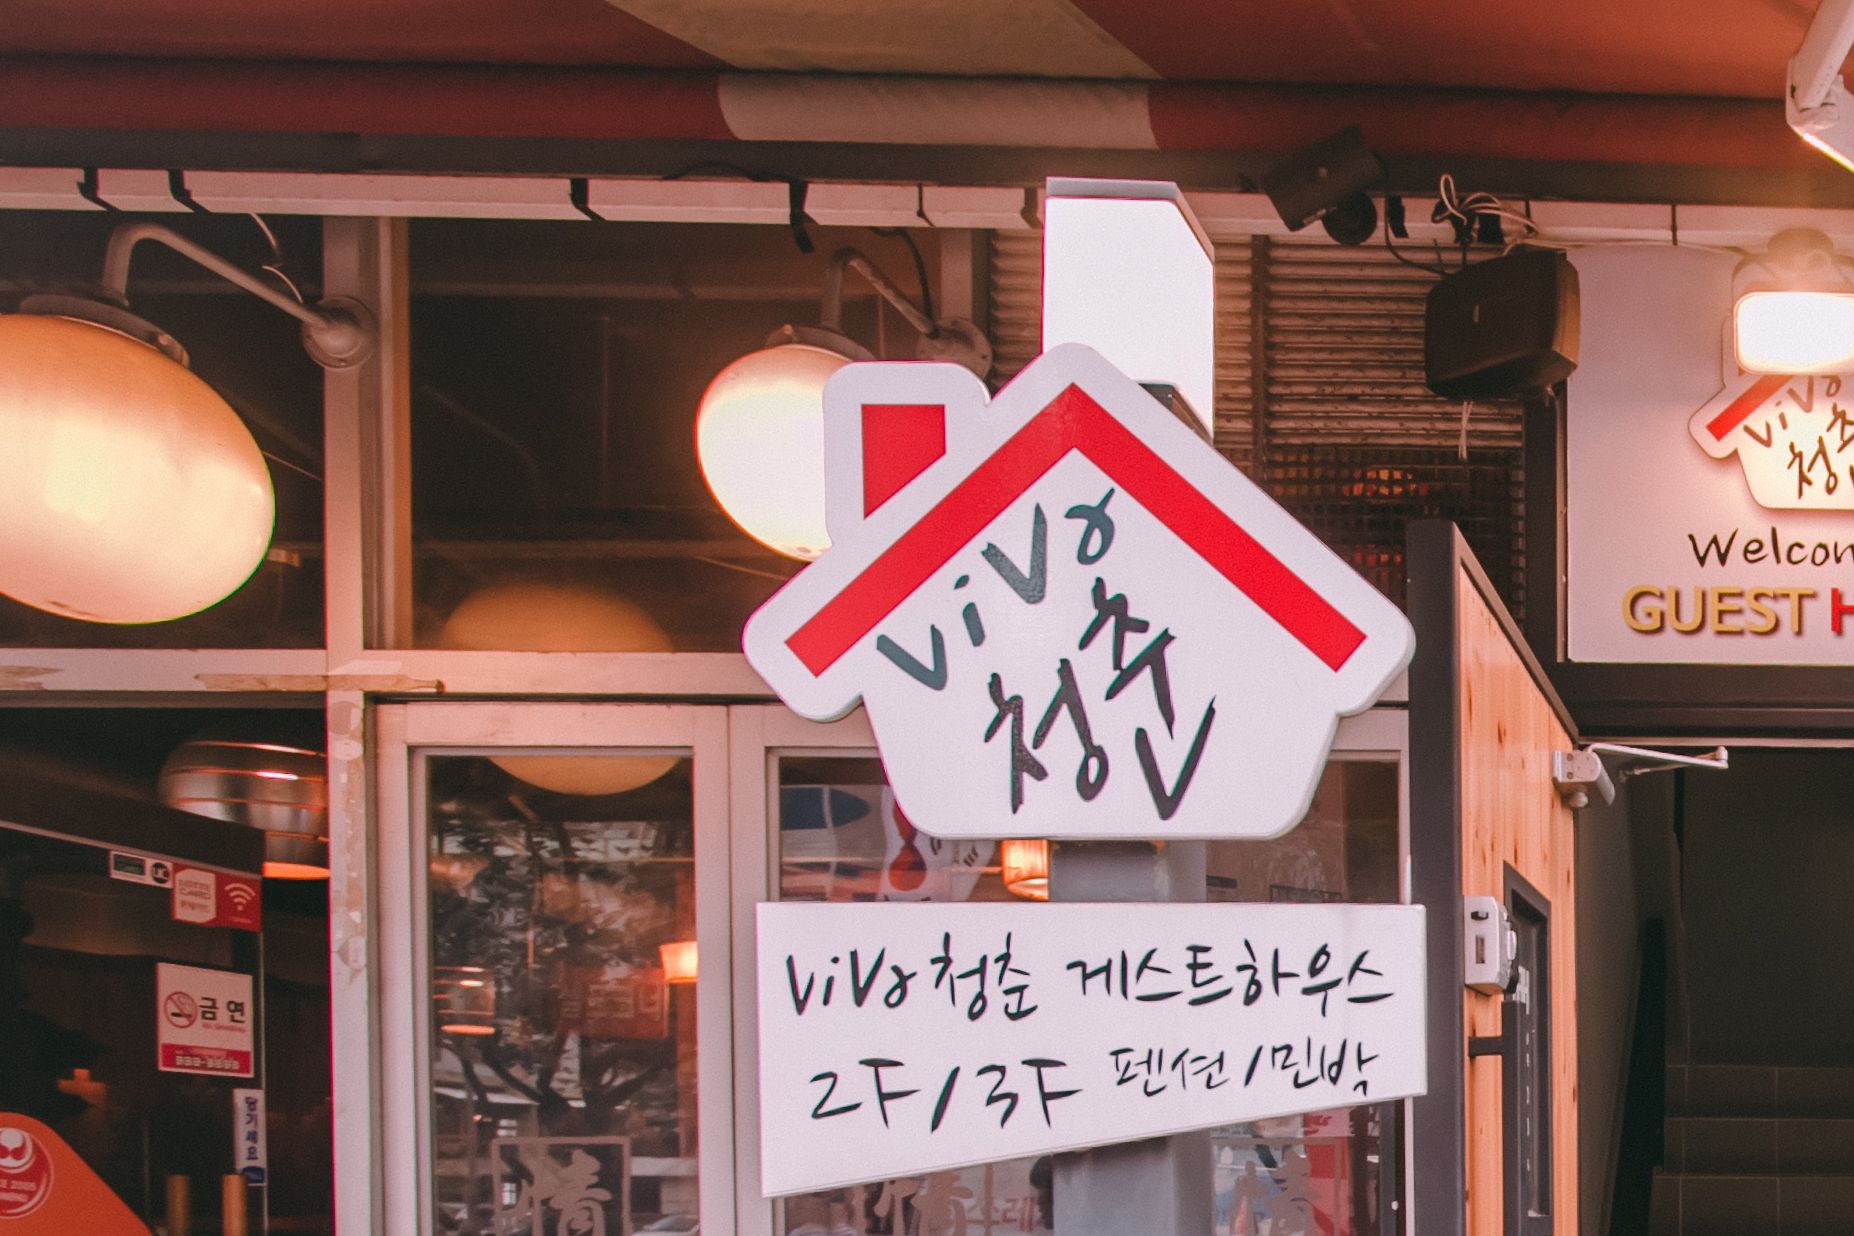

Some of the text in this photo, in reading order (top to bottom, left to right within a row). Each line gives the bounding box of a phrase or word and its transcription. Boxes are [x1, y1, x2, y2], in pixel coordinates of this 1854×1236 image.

[1621, 584, 1816, 638] GUEST
[930, 931, 1039, 1021] 청춘
[1065, 940, 1394, 1017] 게스트하우스
[1109, 1036, 1380, 1096] 펜션/민박
